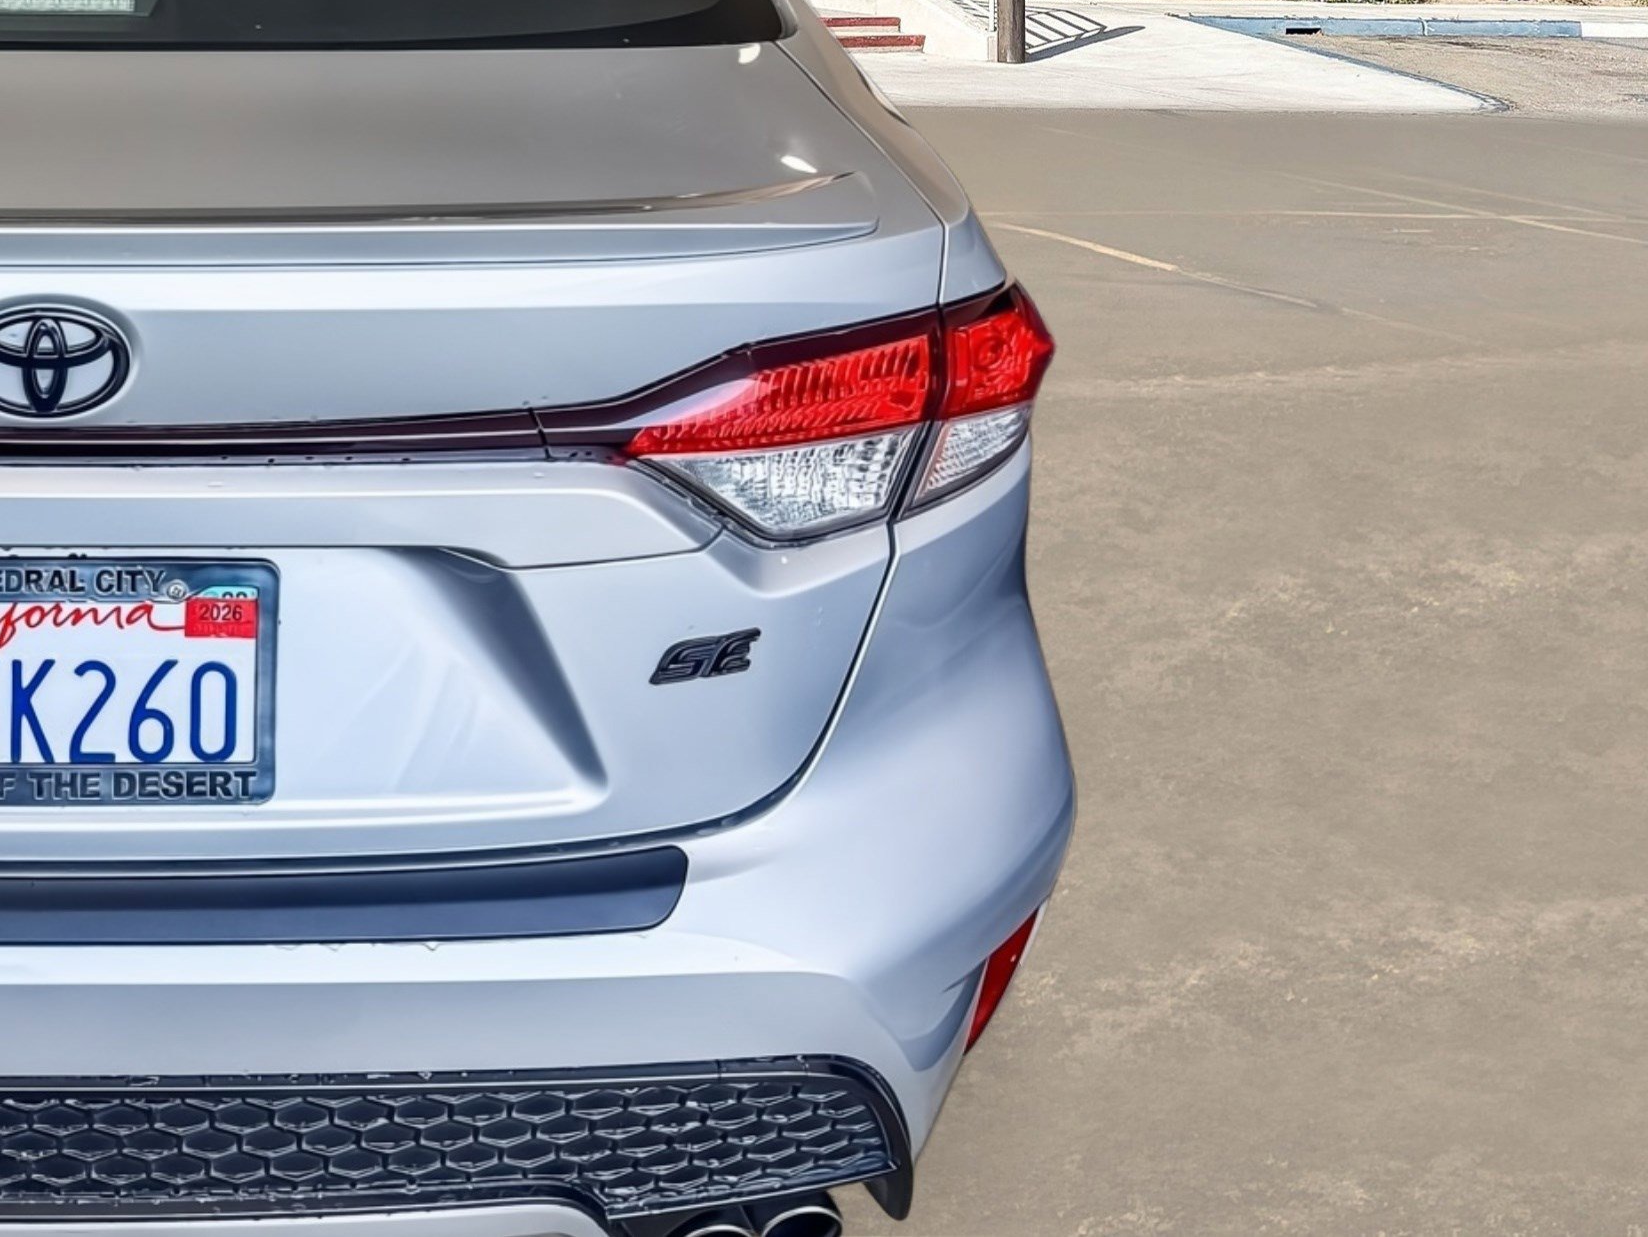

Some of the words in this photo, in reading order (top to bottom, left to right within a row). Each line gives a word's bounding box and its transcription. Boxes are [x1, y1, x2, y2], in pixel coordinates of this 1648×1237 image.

[98, 568, 166, 594] CITY
[198, 603, 243, 621] 2026
[649, 627, 761, 685] SE
[27, 770, 101, 799] THE
[111, 770, 258, 799] DESERT
